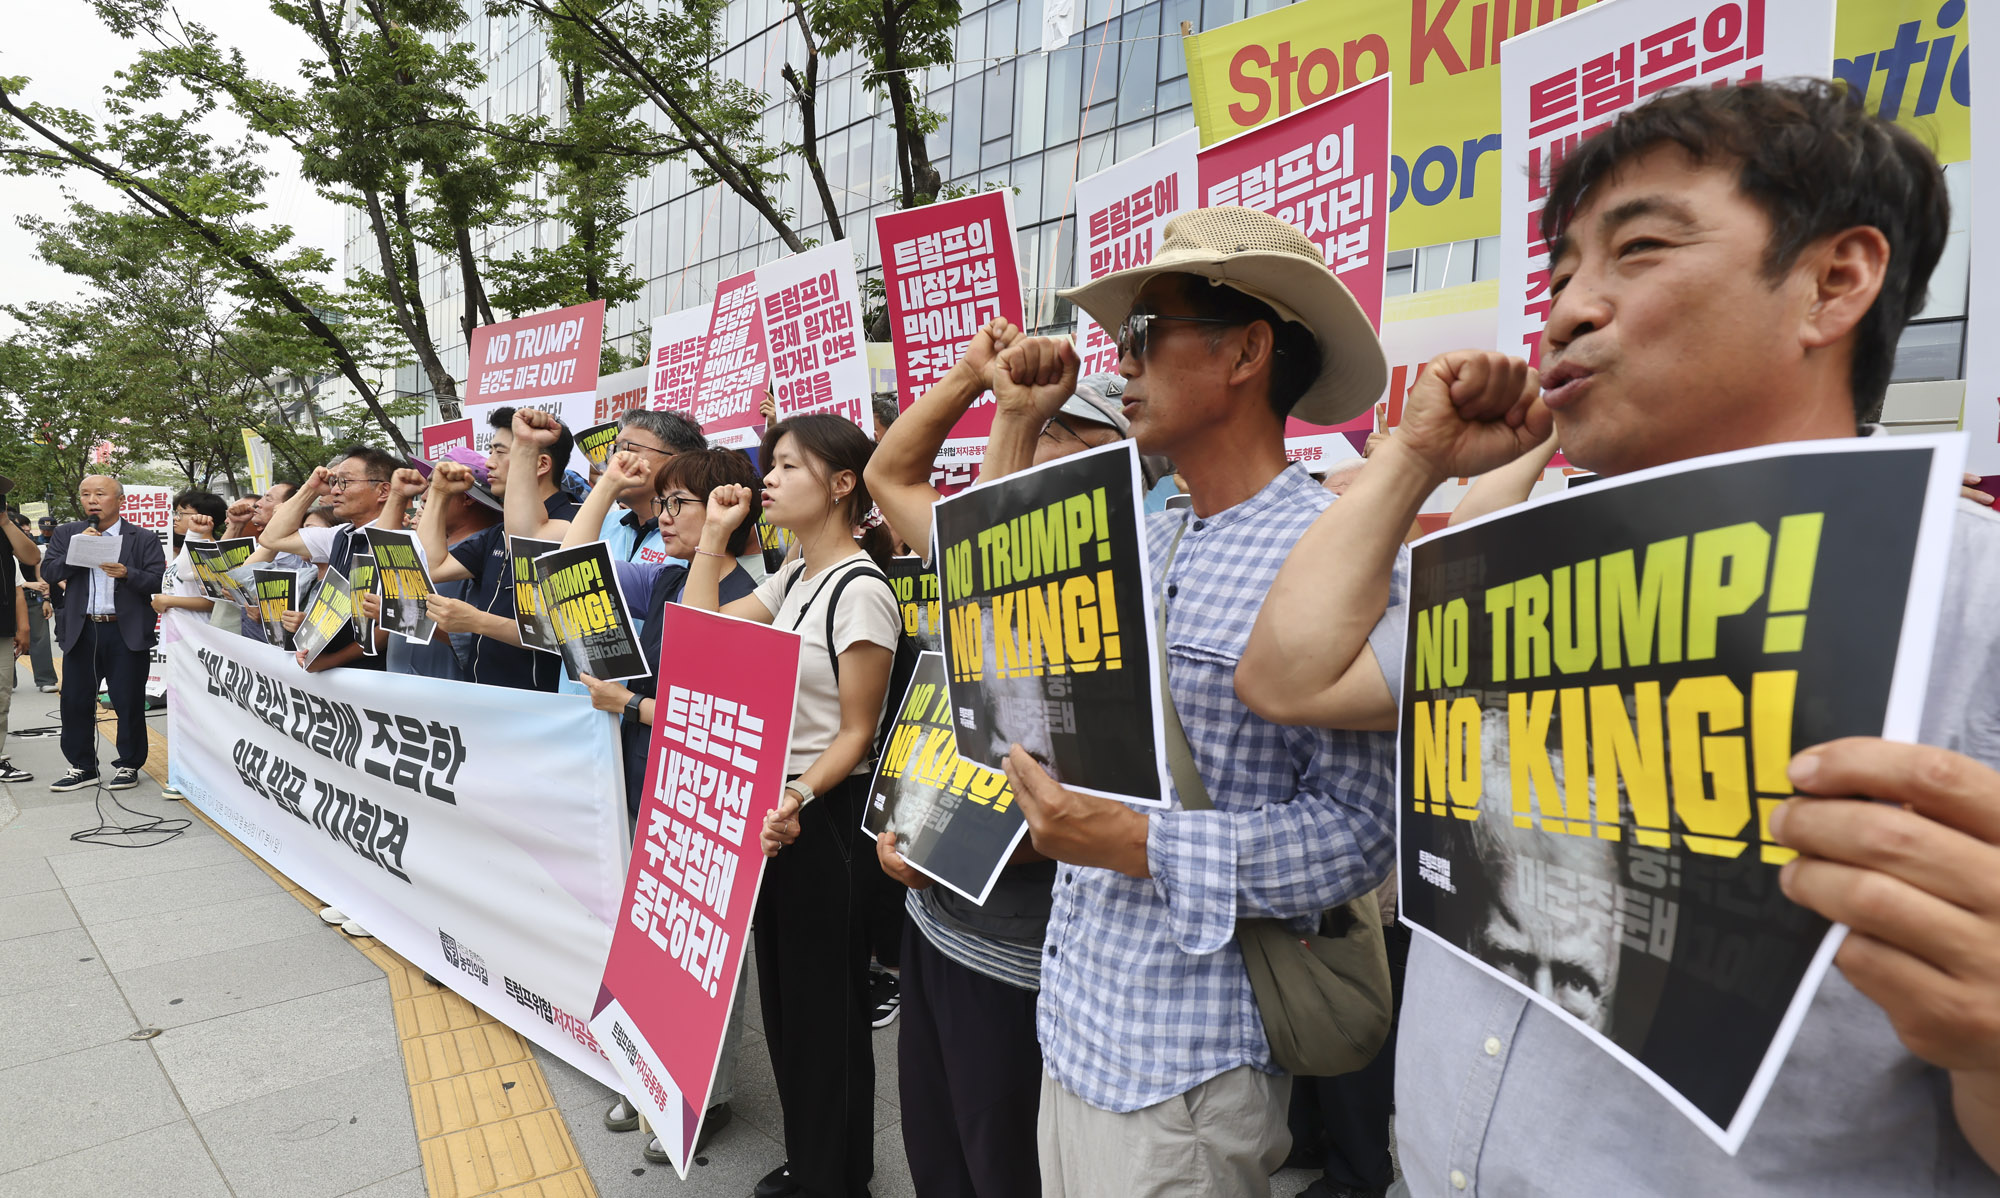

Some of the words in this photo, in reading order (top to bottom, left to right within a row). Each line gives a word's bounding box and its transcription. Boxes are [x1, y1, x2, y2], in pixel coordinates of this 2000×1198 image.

[1228, 33, 1389, 127] Stop
[1529, 0, 1765, 140] 트럼프의
[1208, 123, 1354, 211] 트럼프의
[1090, 172, 1178, 248] 트럼프에
[893, 218, 994, 275] 트럼프의
[764, 269, 839, 326] 트럼프의
[899, 257, 998, 312] 내정간섭
[485, 333, 510, 365] NO
[514, 317, 584, 360] TRUMP!
[708, 326, 749, 359] 위협을
[712, 302, 756, 336] 부당한
[769, 320, 801, 353] 경제
[804, 301, 853, 342] 일자리
[903, 297, 1000, 345] 막아내고
[479, 367, 515, 395] 날강도
[513, 364, 540, 391] 미국
[541, 358, 577, 387] OUT!
[697, 361, 767, 402] 국민주권을
[702, 343, 759, 380] 막아내고
[773, 344, 820, 379] 먹거리
[822, 332, 856, 366] 안보
[778, 371, 833, 413] 위협을
[374, 545, 391, 567] NO
[514, 557, 529, 580] NO
[945, 541, 975, 602] NO
[978, 486, 1112, 592] TRUMP!
[380, 569, 400, 599] NO
[516, 583, 536, 615] NO
[549, 558, 604, 601] TRUMP!
[1415, 597, 1469, 692] NO
[1485, 512, 1825, 683] TRUMP!
[559, 590, 618, 641] KING!
[949, 601, 983, 683] NO
[992, 569, 1122, 680] KING!
[254, 671, 288, 736] 협상
[289, 686, 363, 769] 타결에
[663, 684, 764, 774] 트럼프는
[902, 684, 936, 721] NO
[881, 725, 921, 778] NO
[1414, 697, 1483, 821] NO
[1507, 670, 1799, 866] KING!
[233, 738, 270, 800] 입장
[312, 778, 412, 885] 기자회견
[654, 746, 753, 847] 내정간섭
[643, 807, 738, 920] 주권침해
[630, 868, 731, 999] 중단하라!
[504, 976, 611, 1061] 트럼프위협저지공동
